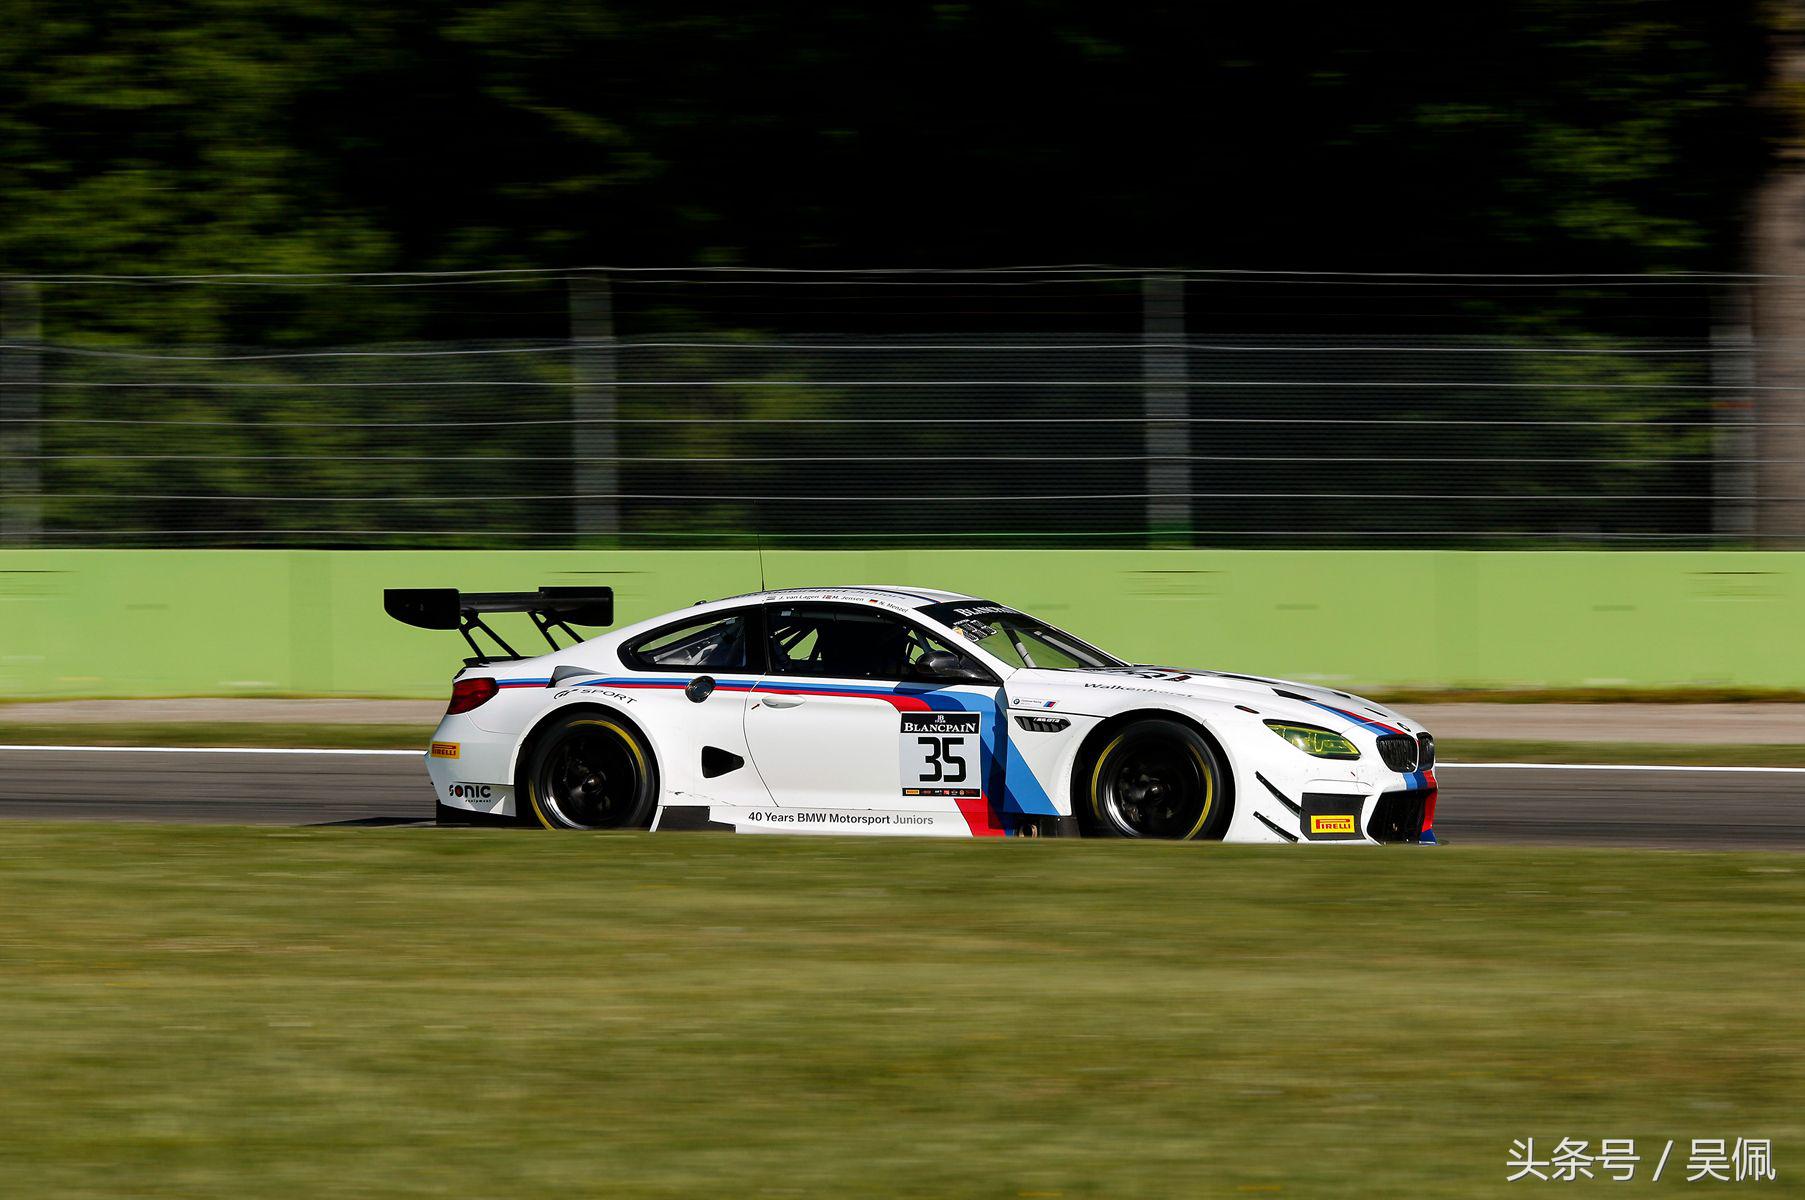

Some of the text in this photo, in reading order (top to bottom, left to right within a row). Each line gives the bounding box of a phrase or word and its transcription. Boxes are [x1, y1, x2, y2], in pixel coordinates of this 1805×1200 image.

[580, 688, 637, 704] SPORT
[903, 722, 977, 733] BLANCPAIN
[918, 736, 967, 783] 35
[748, 811, 934, 826] 40 Years BMW Motorsport Juniors
[1315, 818, 1351, 830] PIRELLI
